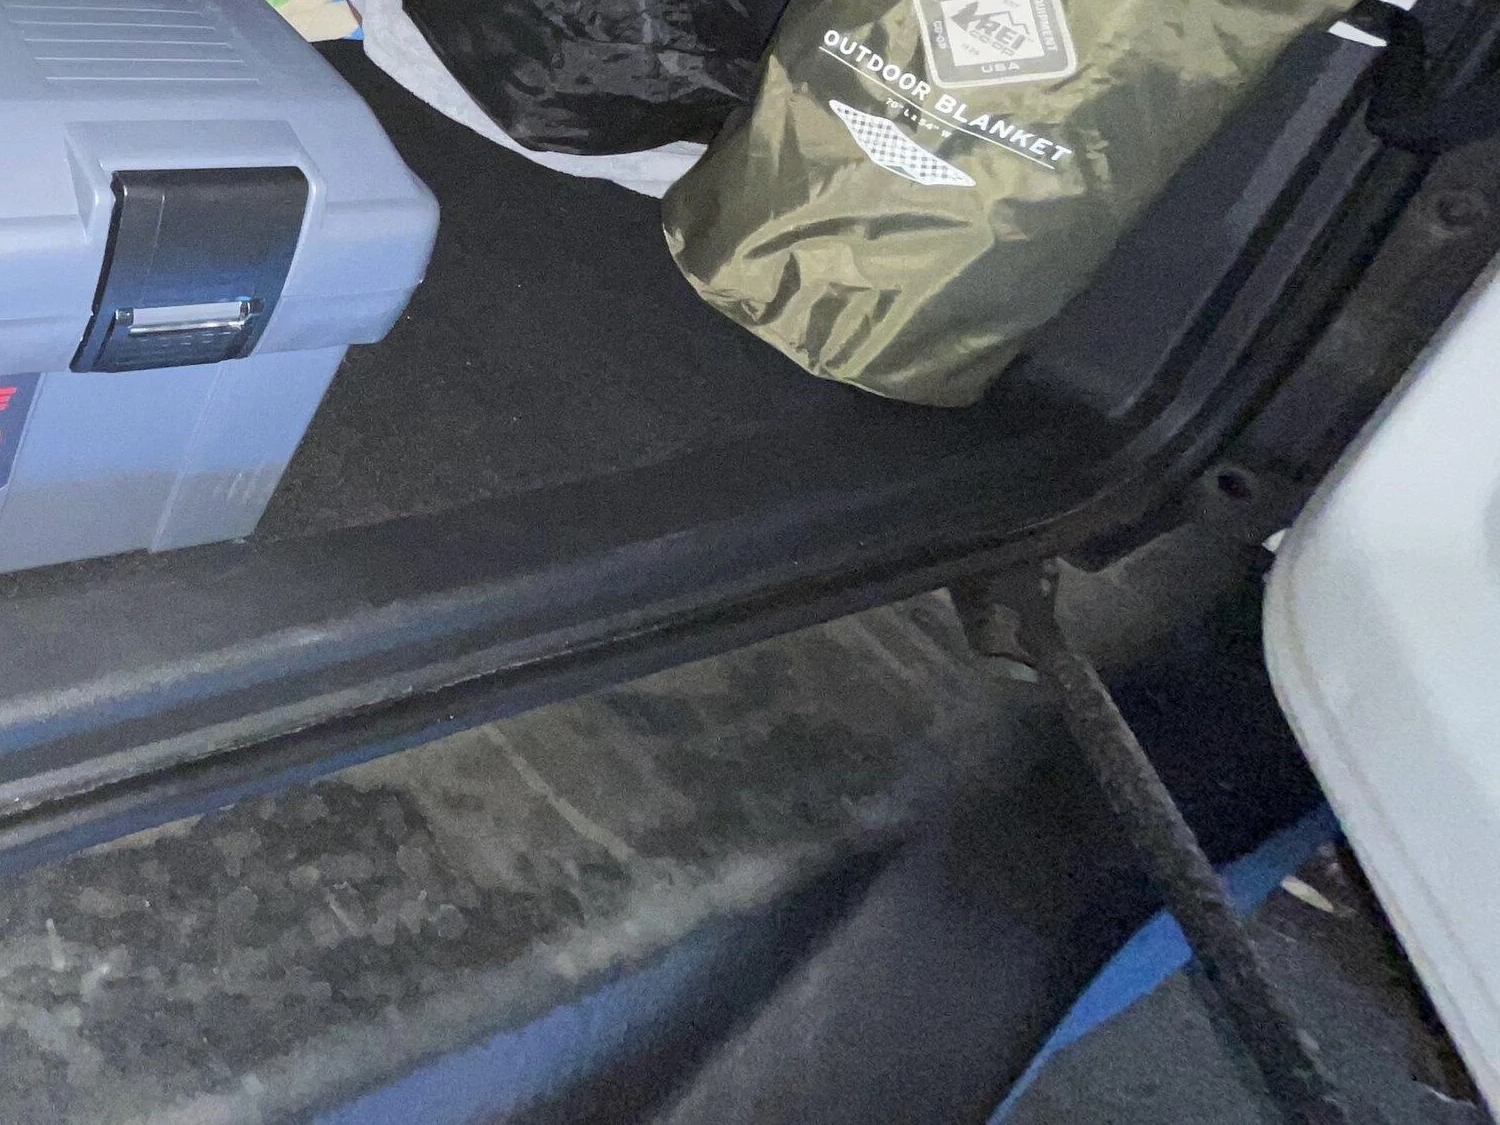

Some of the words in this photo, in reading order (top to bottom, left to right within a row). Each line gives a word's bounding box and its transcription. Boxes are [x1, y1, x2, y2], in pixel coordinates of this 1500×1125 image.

[975, 16, 1025, 51] REI
[981, 62, 1020, 73] USA
[823, 29, 930, 101] OUTDOOR
[935, 93, 1073, 162] BLANKET
